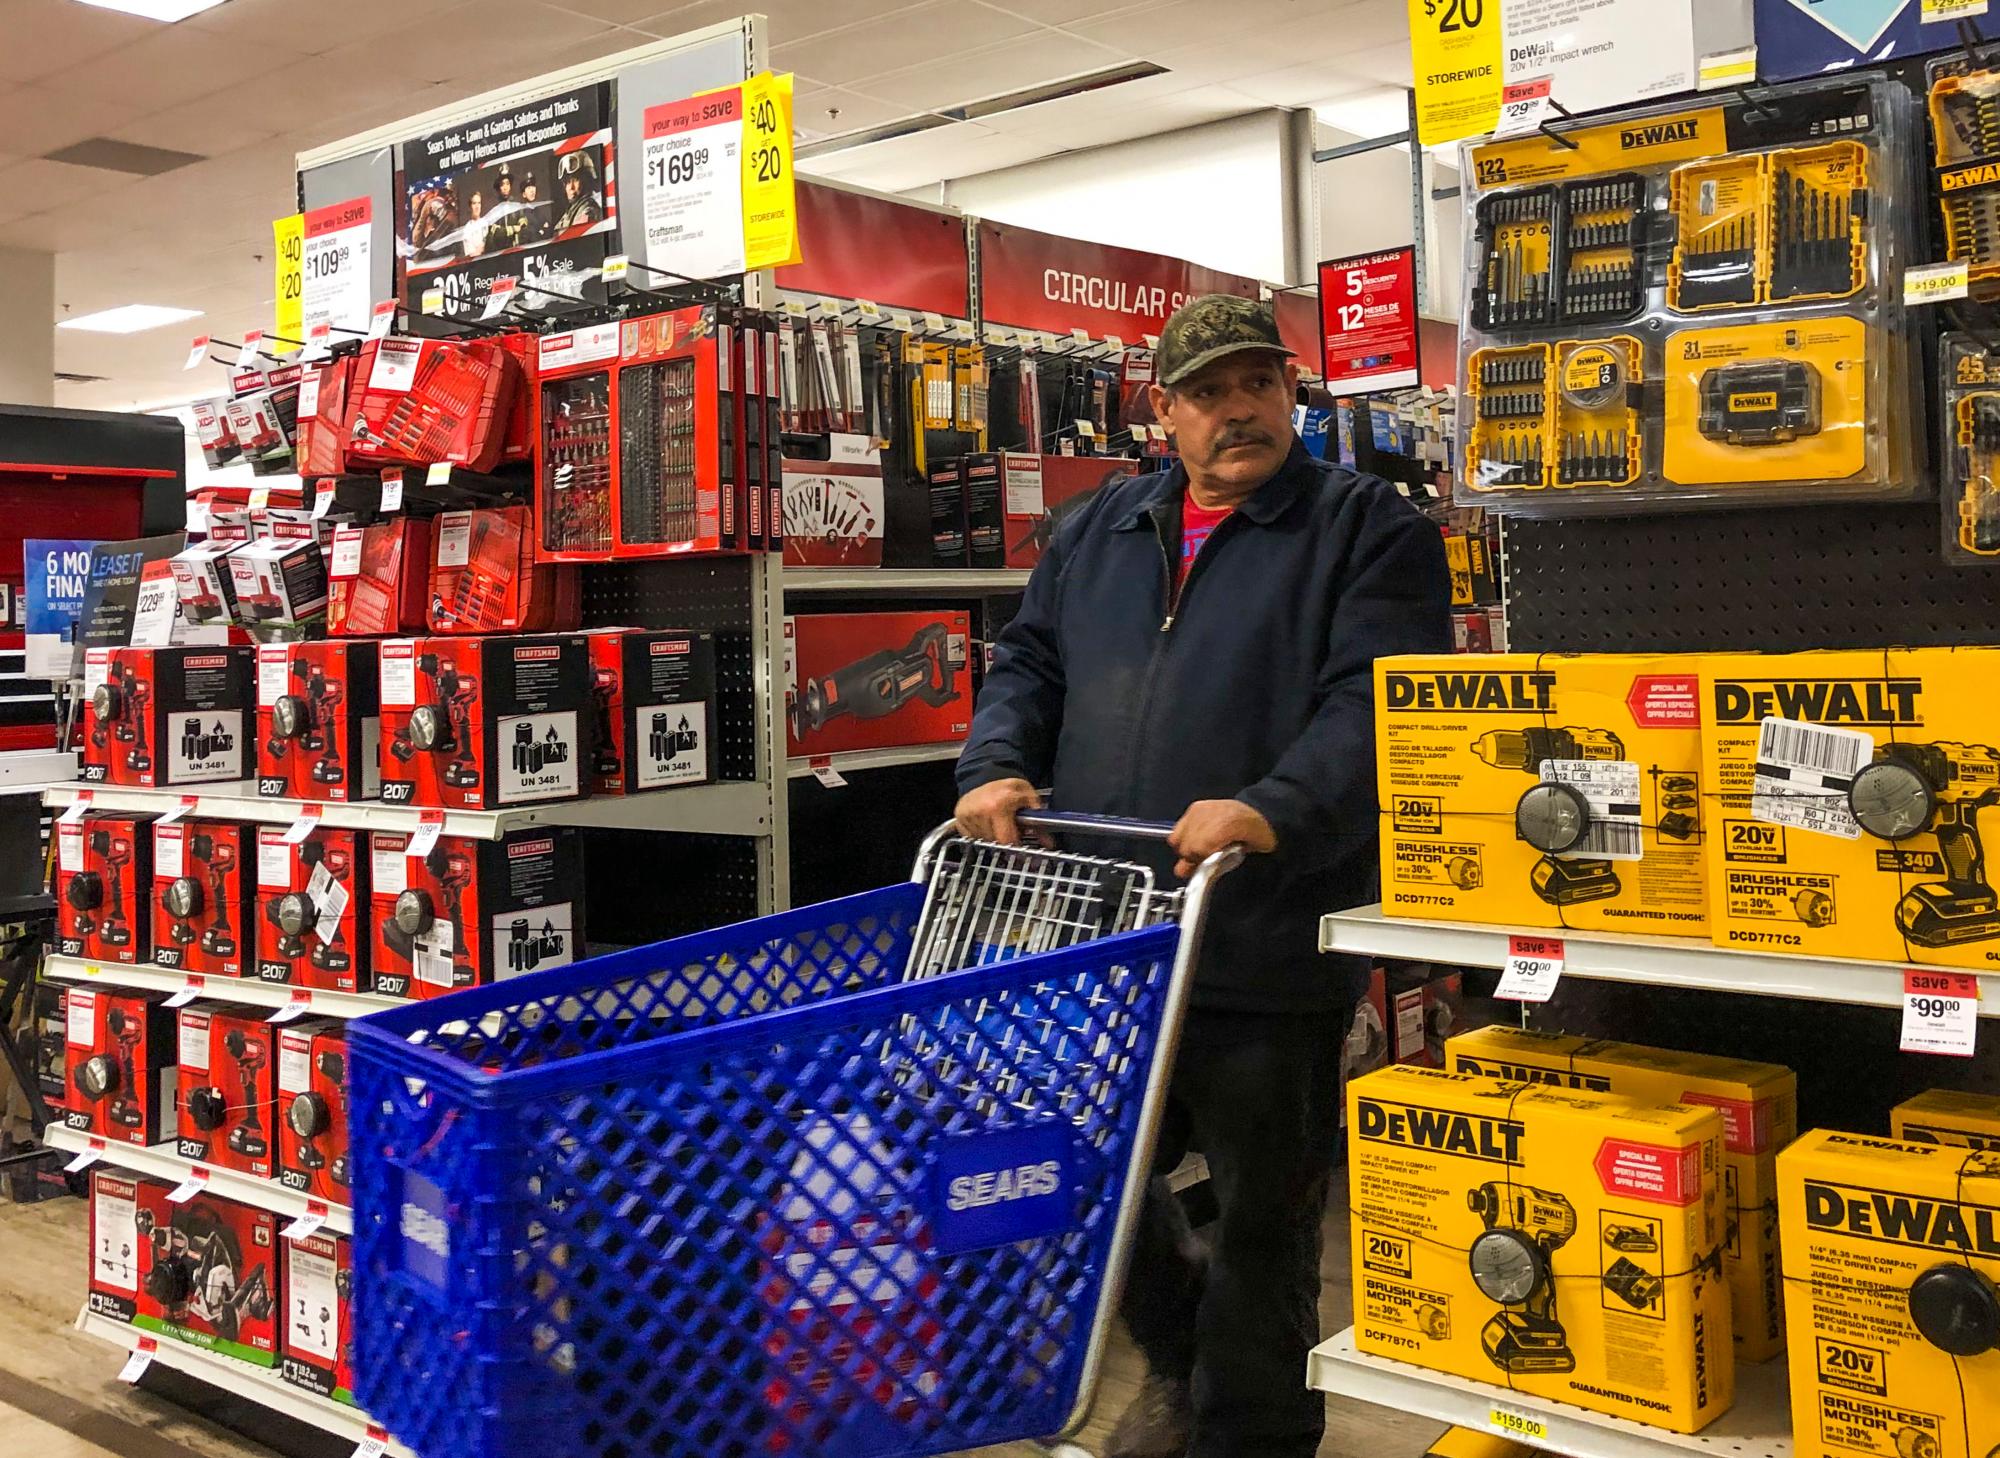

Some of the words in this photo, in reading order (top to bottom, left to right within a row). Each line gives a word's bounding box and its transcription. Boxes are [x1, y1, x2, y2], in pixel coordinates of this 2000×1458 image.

[1425, 0, 1483, 33] $20
[1510, 41, 1554, 62] DeWalt
[1550, 48, 1580, 65] impact
[1582, 41, 1614, 57] wrench
[1426, 65, 1493, 86] STOREWIDE
[1509, 86, 1534, 99] save
[652, 120, 671, 134] your
[673, 114, 690, 128] way
[692, 110, 700, 122] to
[702, 100, 733, 120] save
[750, 100, 776, 136] $40
[428, 140, 444, 156] Sears
[445, 132, 461, 150] Tools
[466, 128, 483, 144] Lawn
[484, 124, 490, 138] &
[490, 117, 514, 136] Garden
[514, 111, 539, 128] Salutes
[540, 104, 553, 121] and
[554, 98, 579, 116] Thanks
[439, 156, 450, 170] our
[451, 148, 474, 165] Military
[475, 140, 497, 158] Heroes
[498, 134, 510, 150] and
[512, 131, 526, 148] First
[527, 122, 567, 144] Responders
[647, 144, 664, 158] your
[666, 136, 692, 150] choice
[751, 146, 780, 182] $20
[1477, 158, 1505, 176] 122
[343, 206, 364, 223] save
[750, 209, 785, 224] STOREWIDE
[649, 224, 683, 238] Craftsman
[281, 236, 300, 264] $40
[319, 237, 337, 248] choice
[552, 258, 574, 274] Sale
[1333, 258, 1369, 272] TARJETA
[1372, 252, 1400, 264] SEARS
[282, 272, 300, 300] $20
[1915, 276, 1956, 291] $19.00
[1044, 268, 1166, 319] CIRCULAR
[1170, 290, 1200, 318] SA
[1364, 305, 1388, 314] MESES
[1389, 302, 1399, 310] DE
[1337, 304, 1365, 331] 12
[1684, 340, 1699, 353] 31
[1957, 356, 1985, 375] 45
[46, 551, 58, 574] 6
[64, 552, 91, 574] MO
[92, 554, 131, 577] LEASE
[132, 552, 143, 573] IT
[46, 576, 88, 598] FINA
[122, 576, 137, 585] TODAY
[47, 602, 56, 612] ON
[58, 602, 77, 612] SELECT
[517, 648, 558, 660] CRAFTSMAN
[651, 643, 688, 653] CRAFTSMAN
[187, 657, 226, 667] CRAFTSMAN
[189, 762, 202, 770] UN
[205, 761, 226, 770] 3481
[658, 765, 669, 773] UN
[671, 762, 692, 772] 3481
[521, 777, 536, 787] UN
[539, 775, 560, 785] 3481
[1610, 788, 1624, 796] 201
[510, 842, 552, 854] CRAFTSMAN
[1396, 842, 1478, 856] BRUSHLESS
[1396, 853, 1442, 863] MOTOR
[1904, 854, 1934, 867] 340
[1411, 865, 1431, 874] 30%
[1730, 874, 1830, 888] BRUSHLESS
[1730, 884, 1787, 896] MOTOR
[1395, 894, 1455, 906] DCD777C2
[1750, 898, 1773, 909] 30%
[1603, 908, 1666, 921] GUARANTEED
[1729, 931, 1801, 945] DCD777C2
[1516, 940, 1544, 954] save
[1912, 976, 1949, 990] save
[99, 1179, 136, 1197] CRAFTSMAN
[946, 1160, 1062, 1211] SEARS
[1809, 1253, 1841, 1265] IMPACT
[1844, 1260, 1876, 1272] DRIVER
[1874, 1257, 1918, 1270] COMPACT
[1811, 1271, 1839, 1281] JUEGO
[1366, 1280, 1446, 1305] BRUSHLESS
[1367, 1290, 1412, 1308] MOTOR
[1382, 1305, 1400, 1317] 30%
[1813, 1304, 1859, 1320] ENSEMBLE
[1862, 1314, 1904, 1328] VISSEUSE
[161, 1323, 213, 1346] LITHIUM-ION
[1814, 1313, 1868, 1330] PERCUSSION
[1870, 1324, 1921, 1341] COMPACTE
[257, 1338, 270, 1347] YEAR
[1365, 1329, 1420, 1350] DCF787C1
[1569, 1381, 1632, 1403] GUARANTEED
[1823, 1396, 1935, 1429] BRUSHLESS
[1824, 1408, 1888, 1431] MOTOR
[1496, 1412, 1540, 1435] $159.00
[1846, 1426, 1872, 1442] 30%
